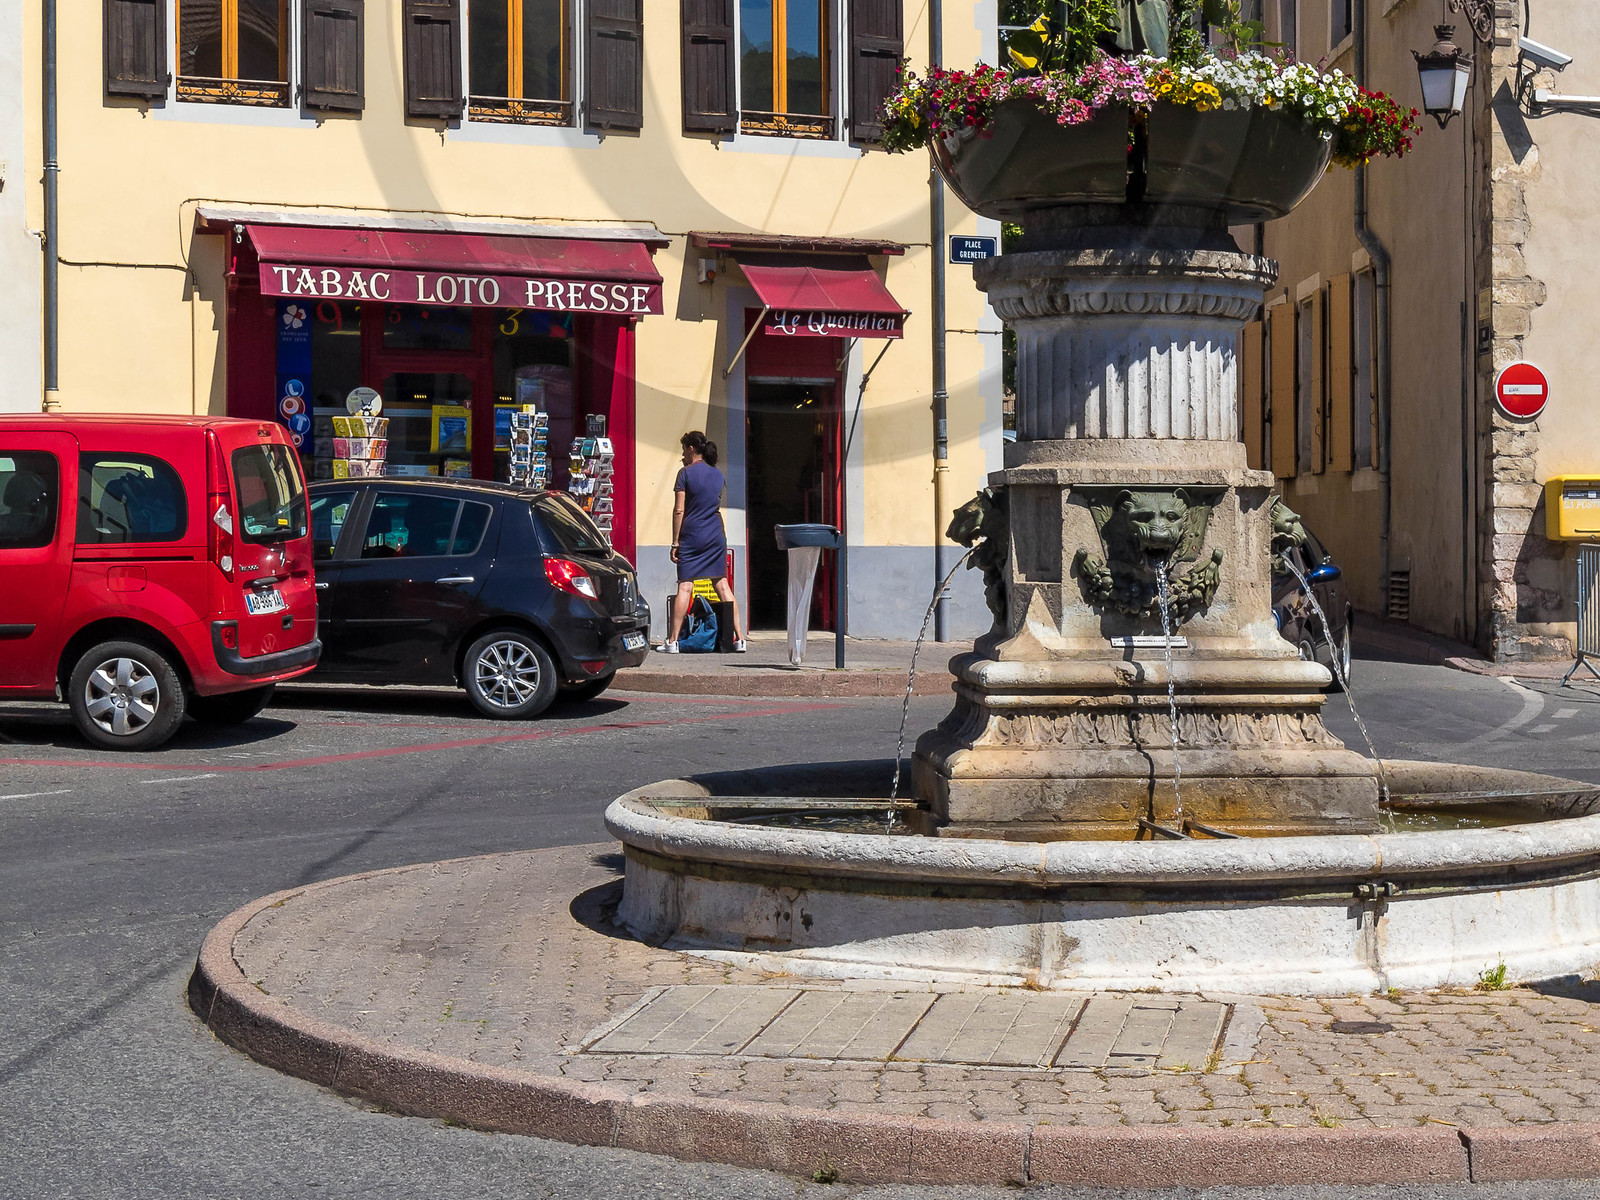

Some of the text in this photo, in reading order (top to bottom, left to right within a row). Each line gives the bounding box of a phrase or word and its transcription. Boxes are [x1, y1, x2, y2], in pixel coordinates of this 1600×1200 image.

[964, 240, 982, 249] PLACE
[959, 250, 987, 259] GRENETTE
[272, 266, 652, 312] TABAC LOTO PRESSE
[773, 310, 896, 336] Le Quotidien
